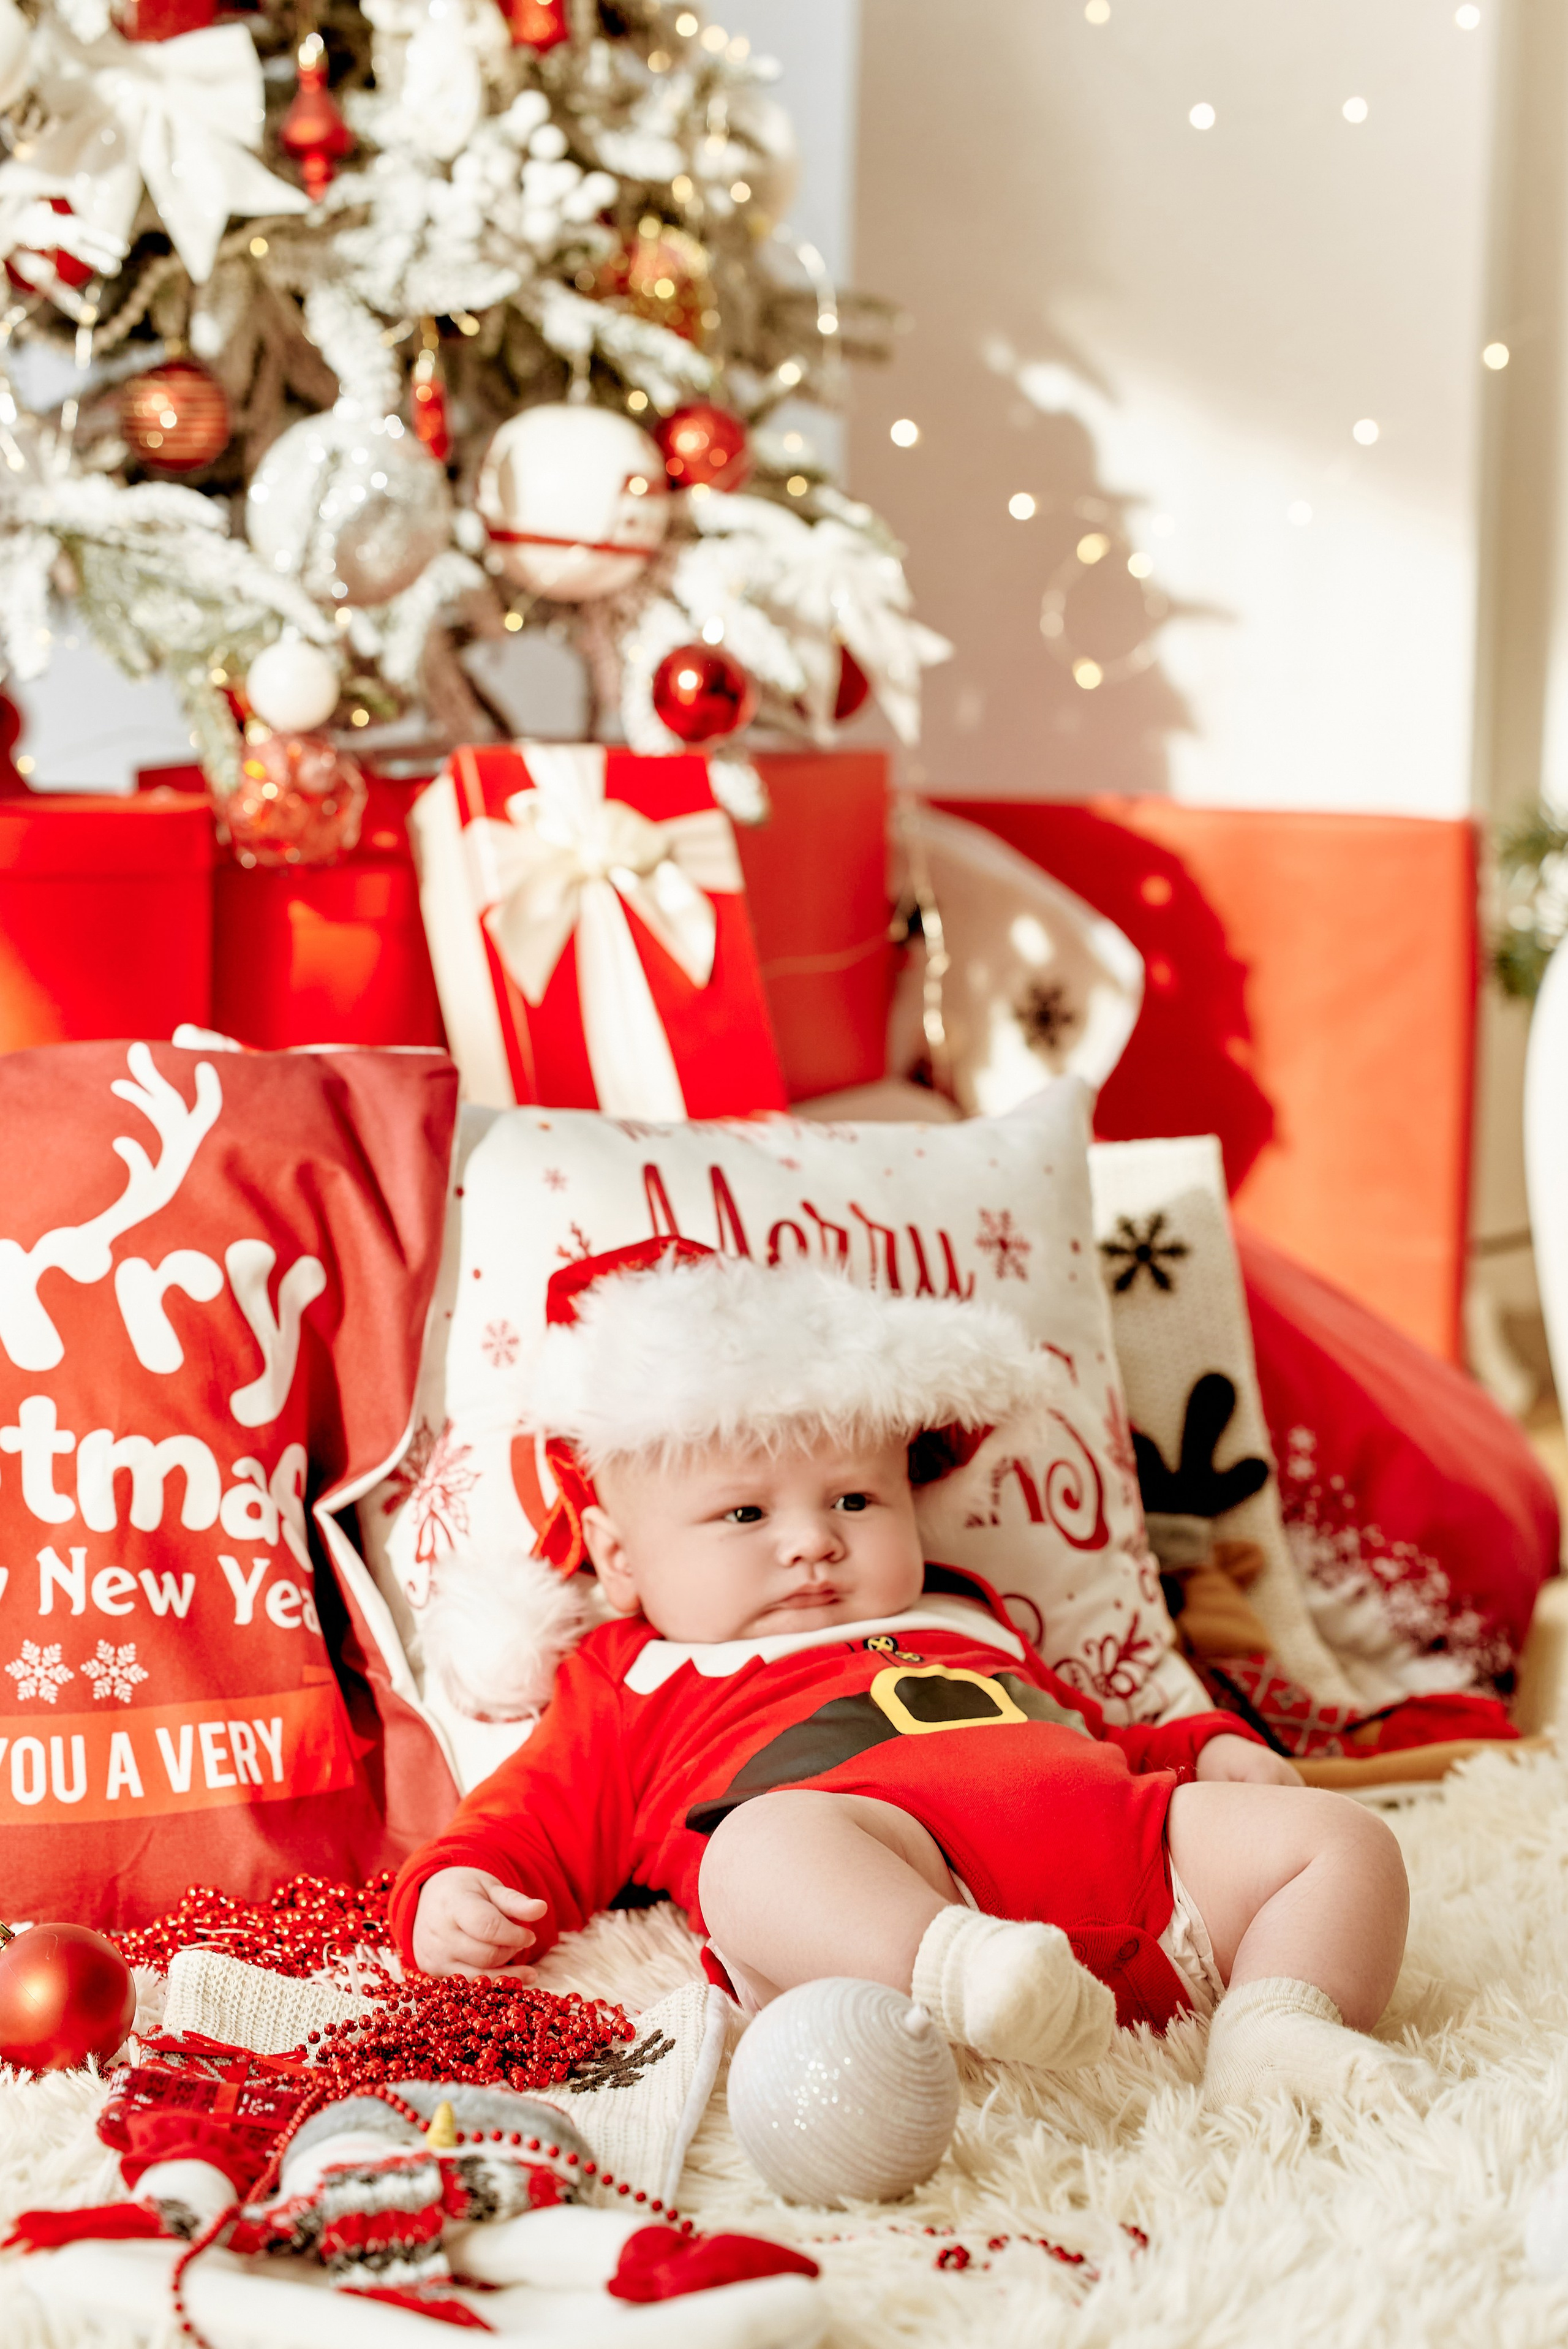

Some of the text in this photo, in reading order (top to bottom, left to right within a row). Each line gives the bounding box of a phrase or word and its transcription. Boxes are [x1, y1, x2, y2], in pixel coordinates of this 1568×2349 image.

[36, 1545, 196, 1619] New
[105, 1730, 145, 1801] A
[155, 1716, 284, 1794] VERY
